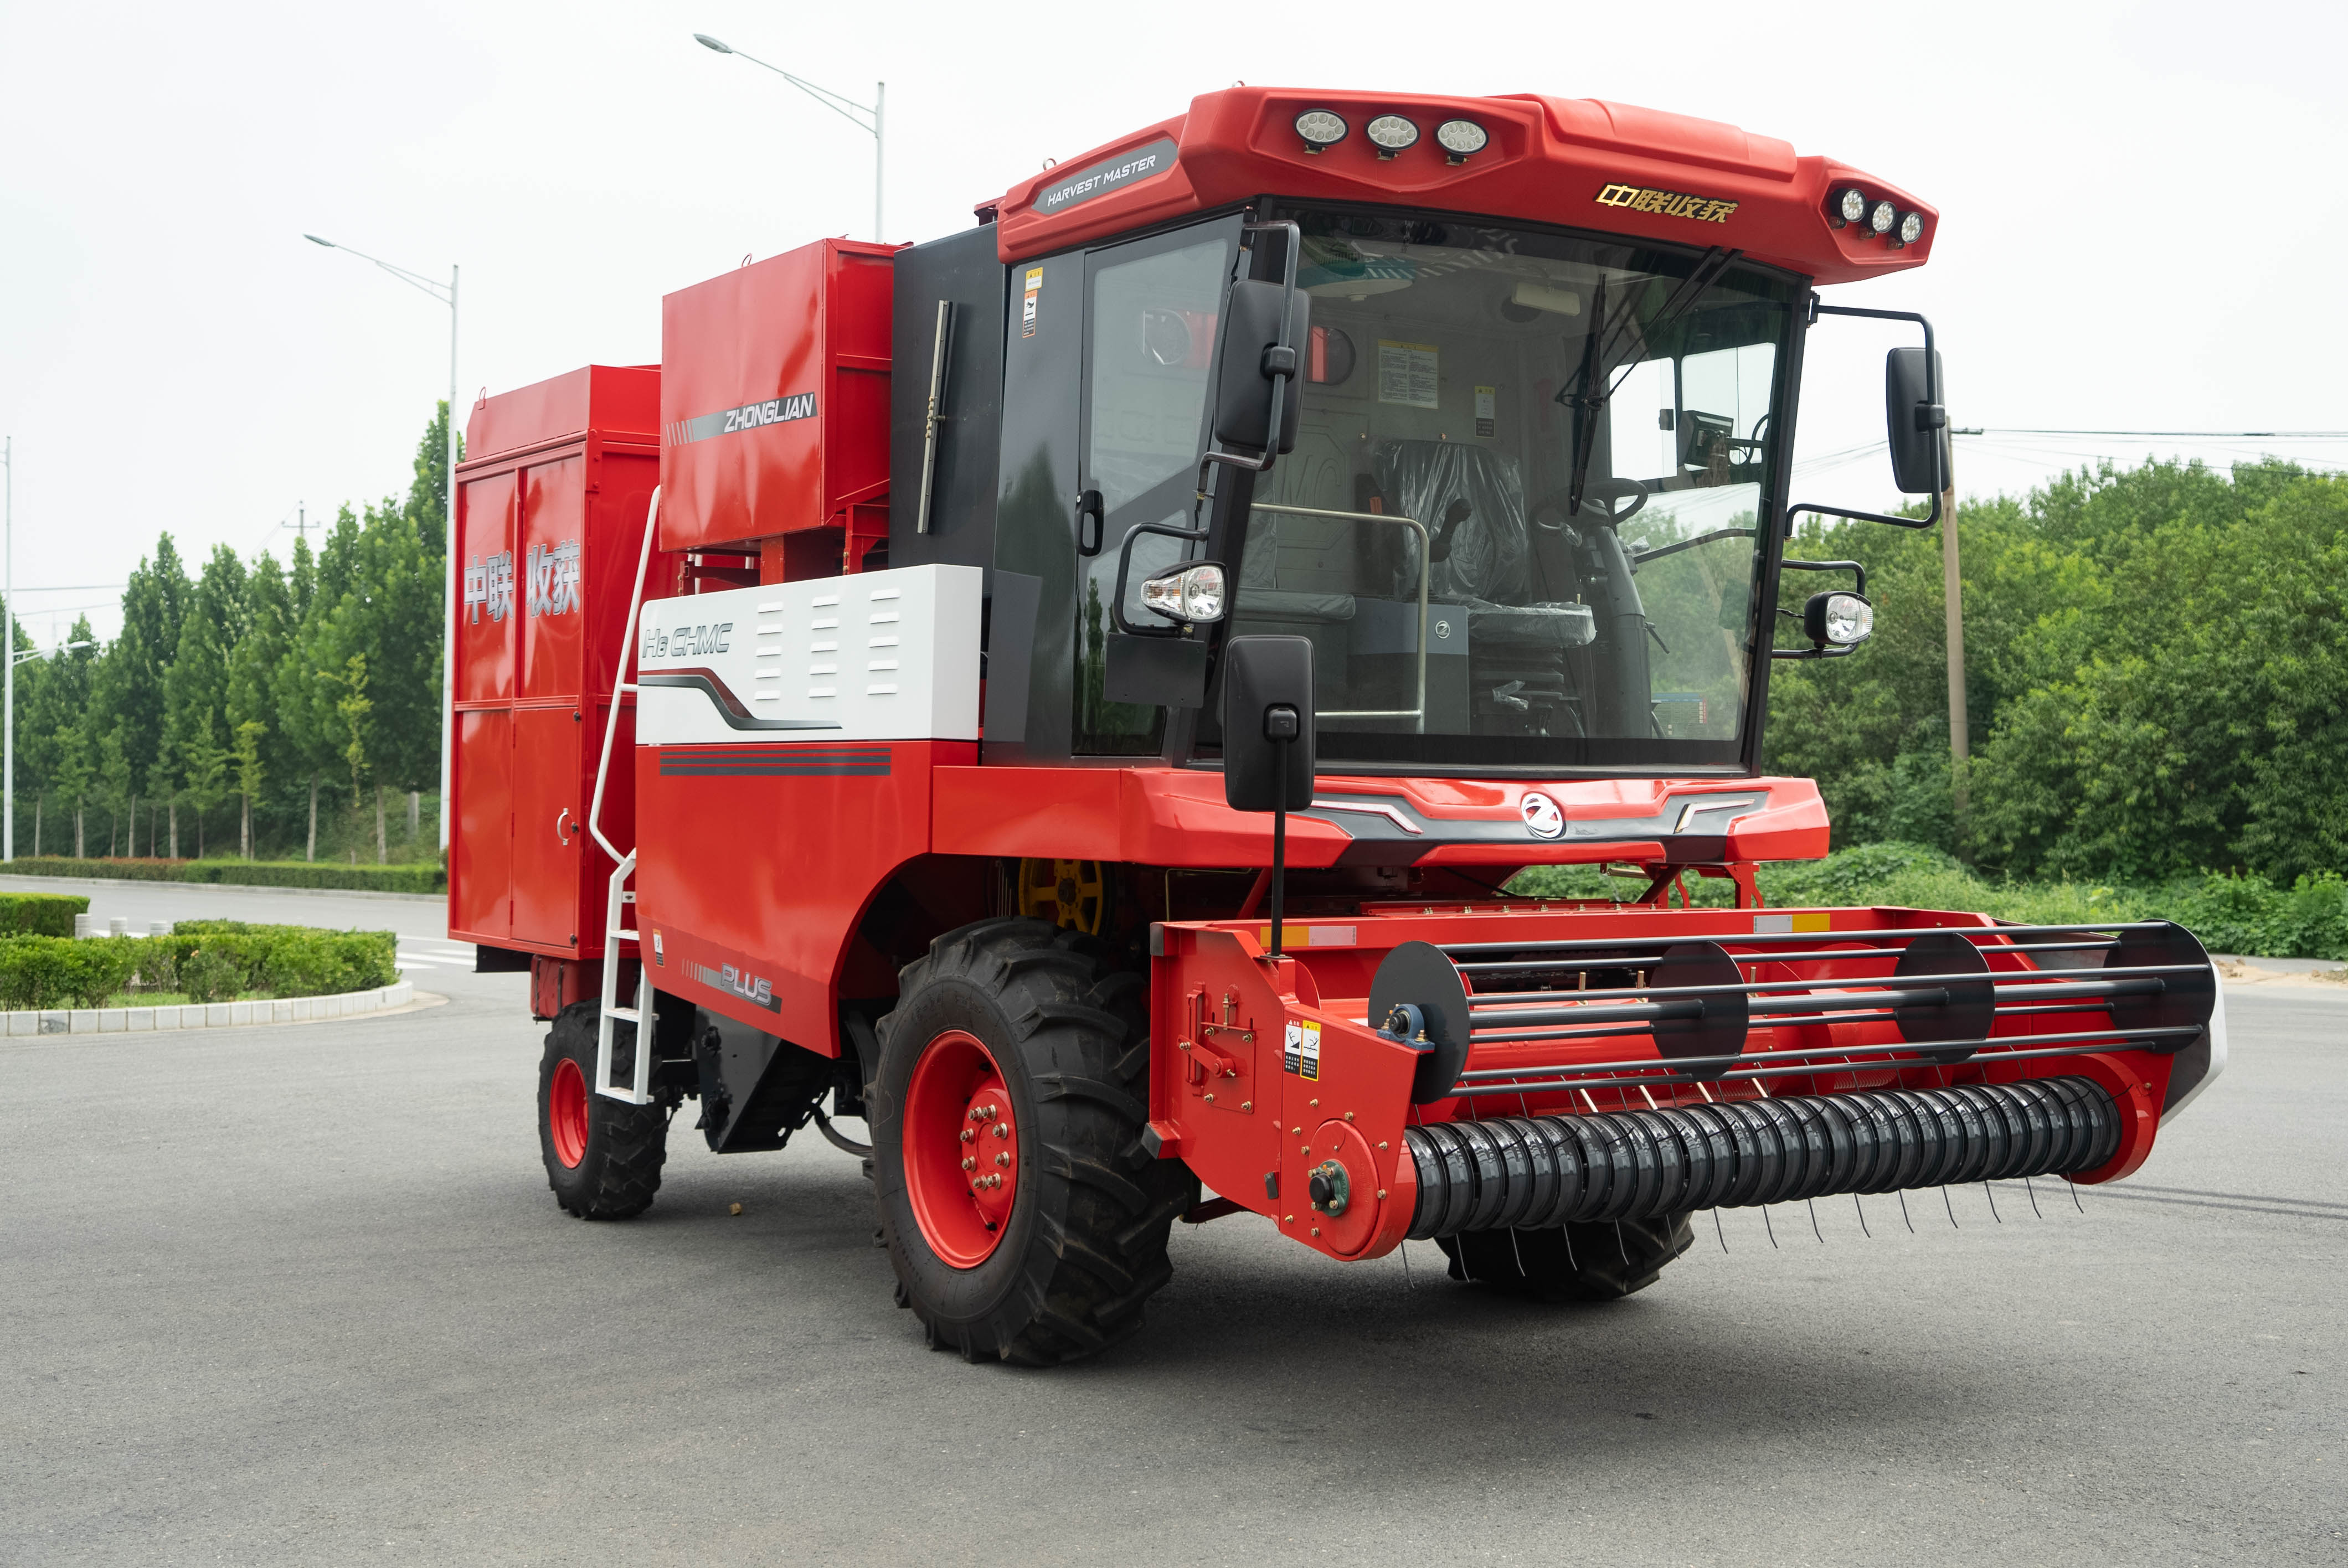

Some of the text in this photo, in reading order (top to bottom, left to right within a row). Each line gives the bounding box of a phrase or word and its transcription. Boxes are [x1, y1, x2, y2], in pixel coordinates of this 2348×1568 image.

[1047, 154, 1156, 207] HARVEST MASTER
[1595, 184, 1739, 223] 中联收获
[724, 394, 814, 433] ZHONGLIAN
[670, 623, 733, 657] CHMC
[721, 962, 773, 1006] PLUS
